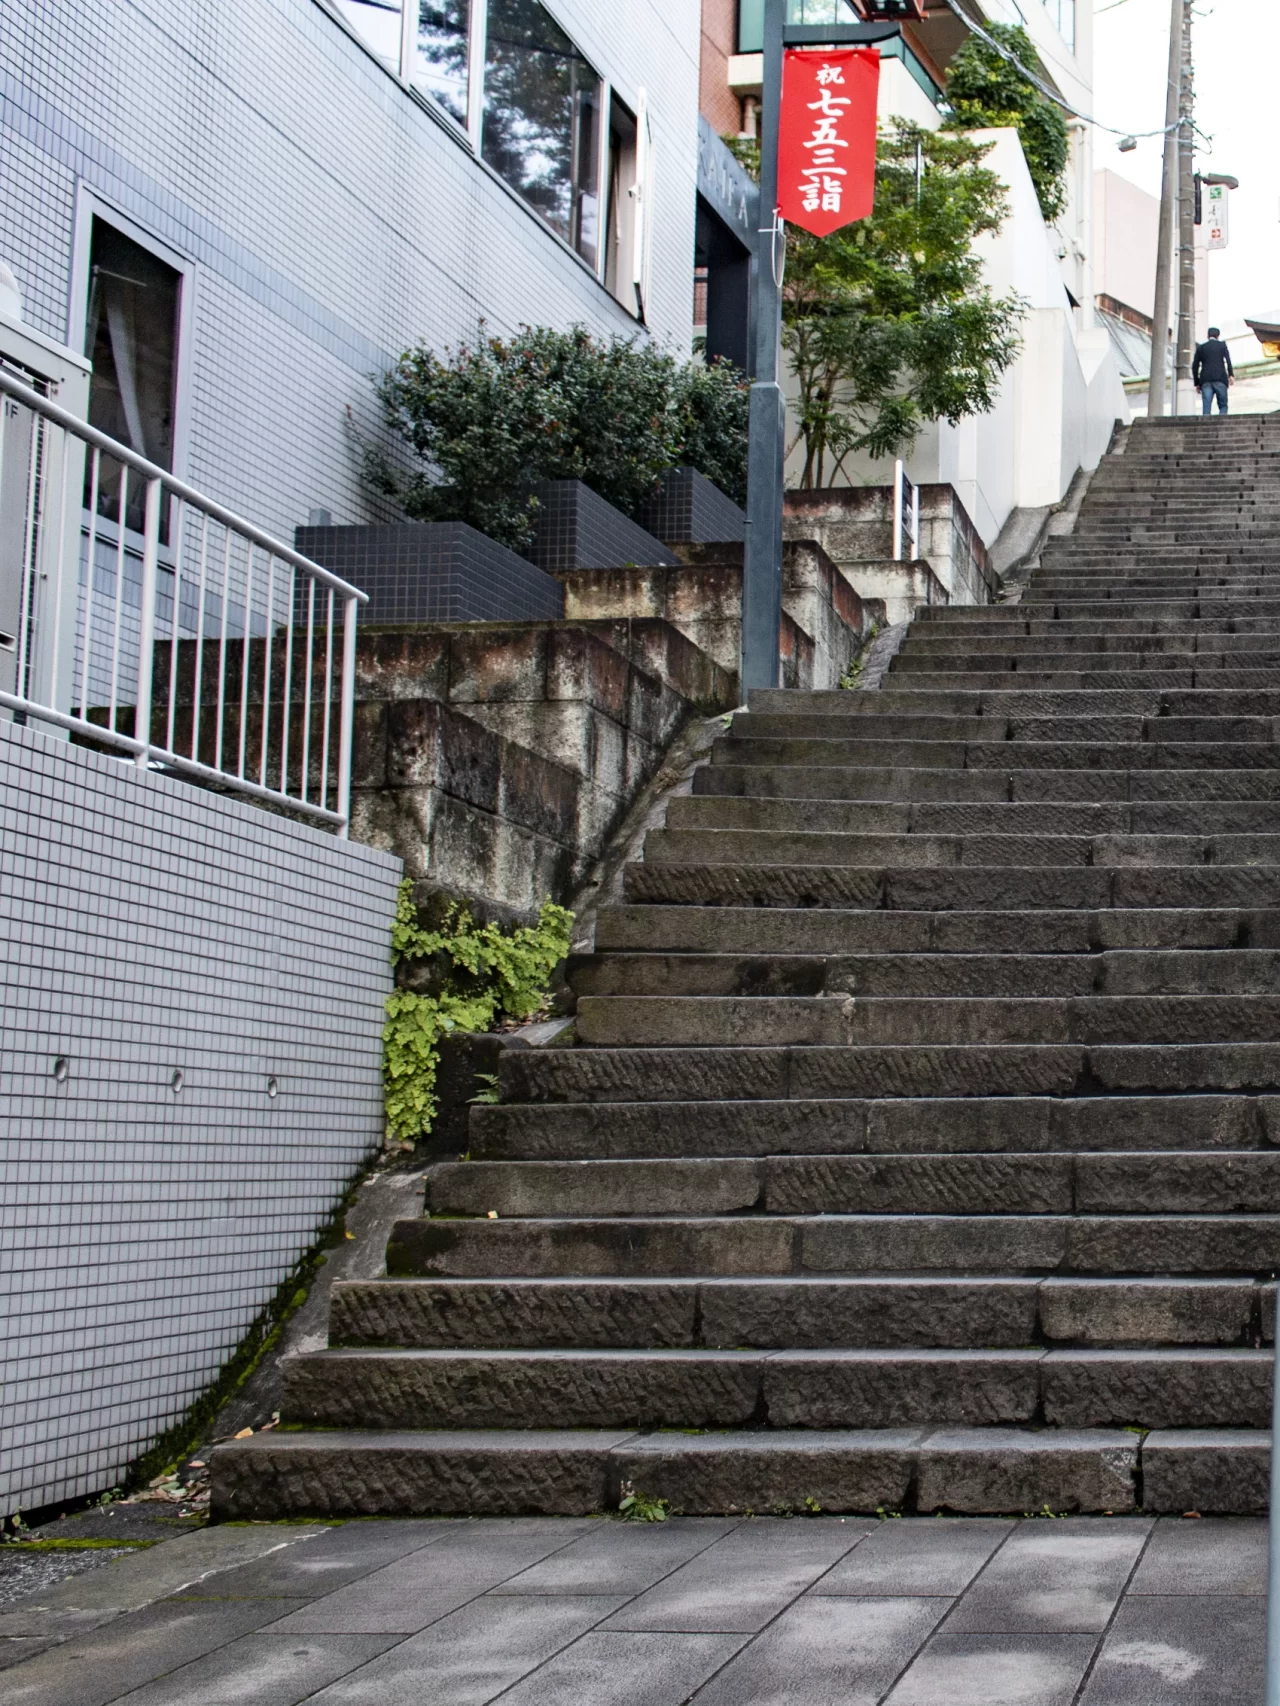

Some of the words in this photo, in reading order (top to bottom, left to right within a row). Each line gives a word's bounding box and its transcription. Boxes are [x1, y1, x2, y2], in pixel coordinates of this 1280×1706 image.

[798, 64, 852, 213] 祝七五三詣
